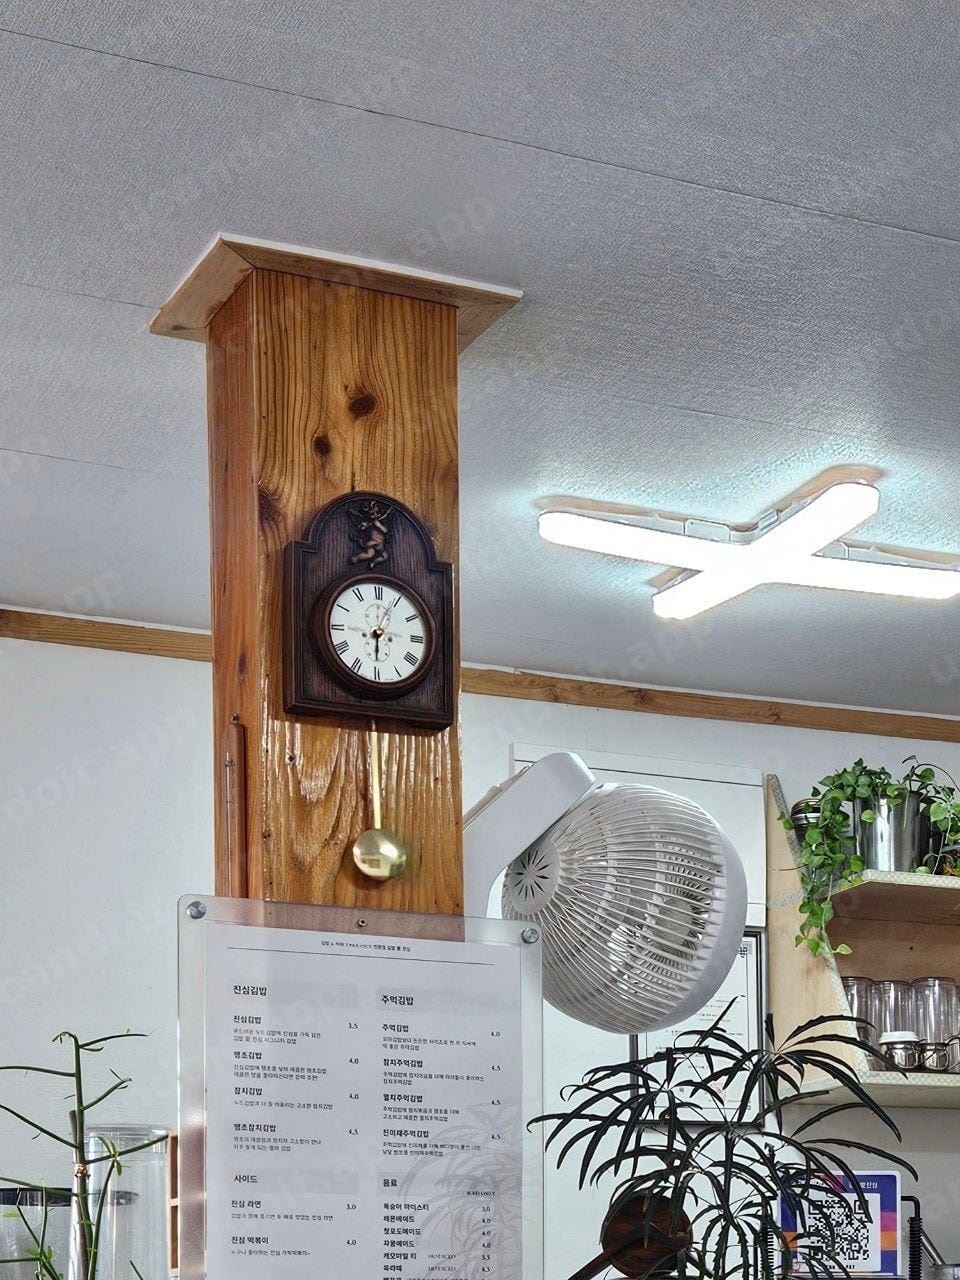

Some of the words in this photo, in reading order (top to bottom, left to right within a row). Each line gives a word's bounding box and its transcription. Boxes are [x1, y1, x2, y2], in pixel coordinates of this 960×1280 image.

[233, 985, 268, 996] 진심김밥
[234, 1086, 263, 1096] 참치김밥
[234, 1174, 258, 1184] 사이드
[383, 1179, 398, 1188] 음료
